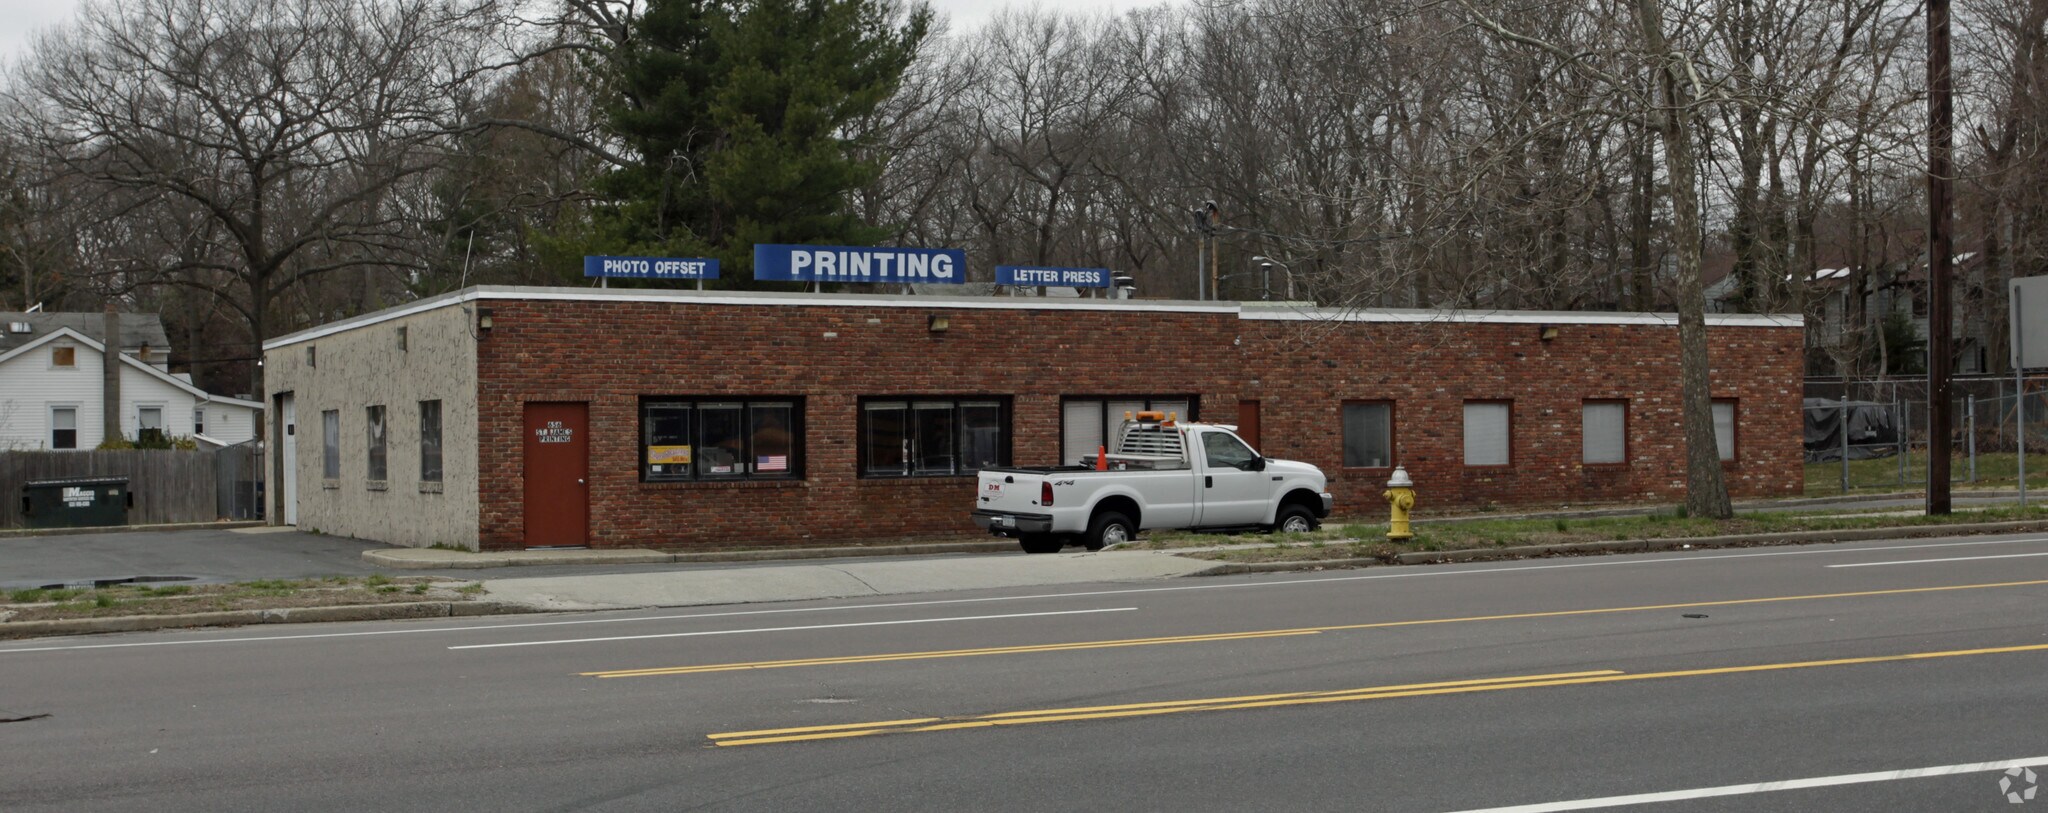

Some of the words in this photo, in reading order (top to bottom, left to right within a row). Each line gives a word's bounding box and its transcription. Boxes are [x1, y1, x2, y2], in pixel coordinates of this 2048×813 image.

[603, 259, 649, 274] PHOTO
[654, 261, 706, 275] OFFSET
[791, 250, 953, 279] PRINTING
[1014, 270, 1059, 282] LETTER
[1063, 271, 1101, 283] PRESS
